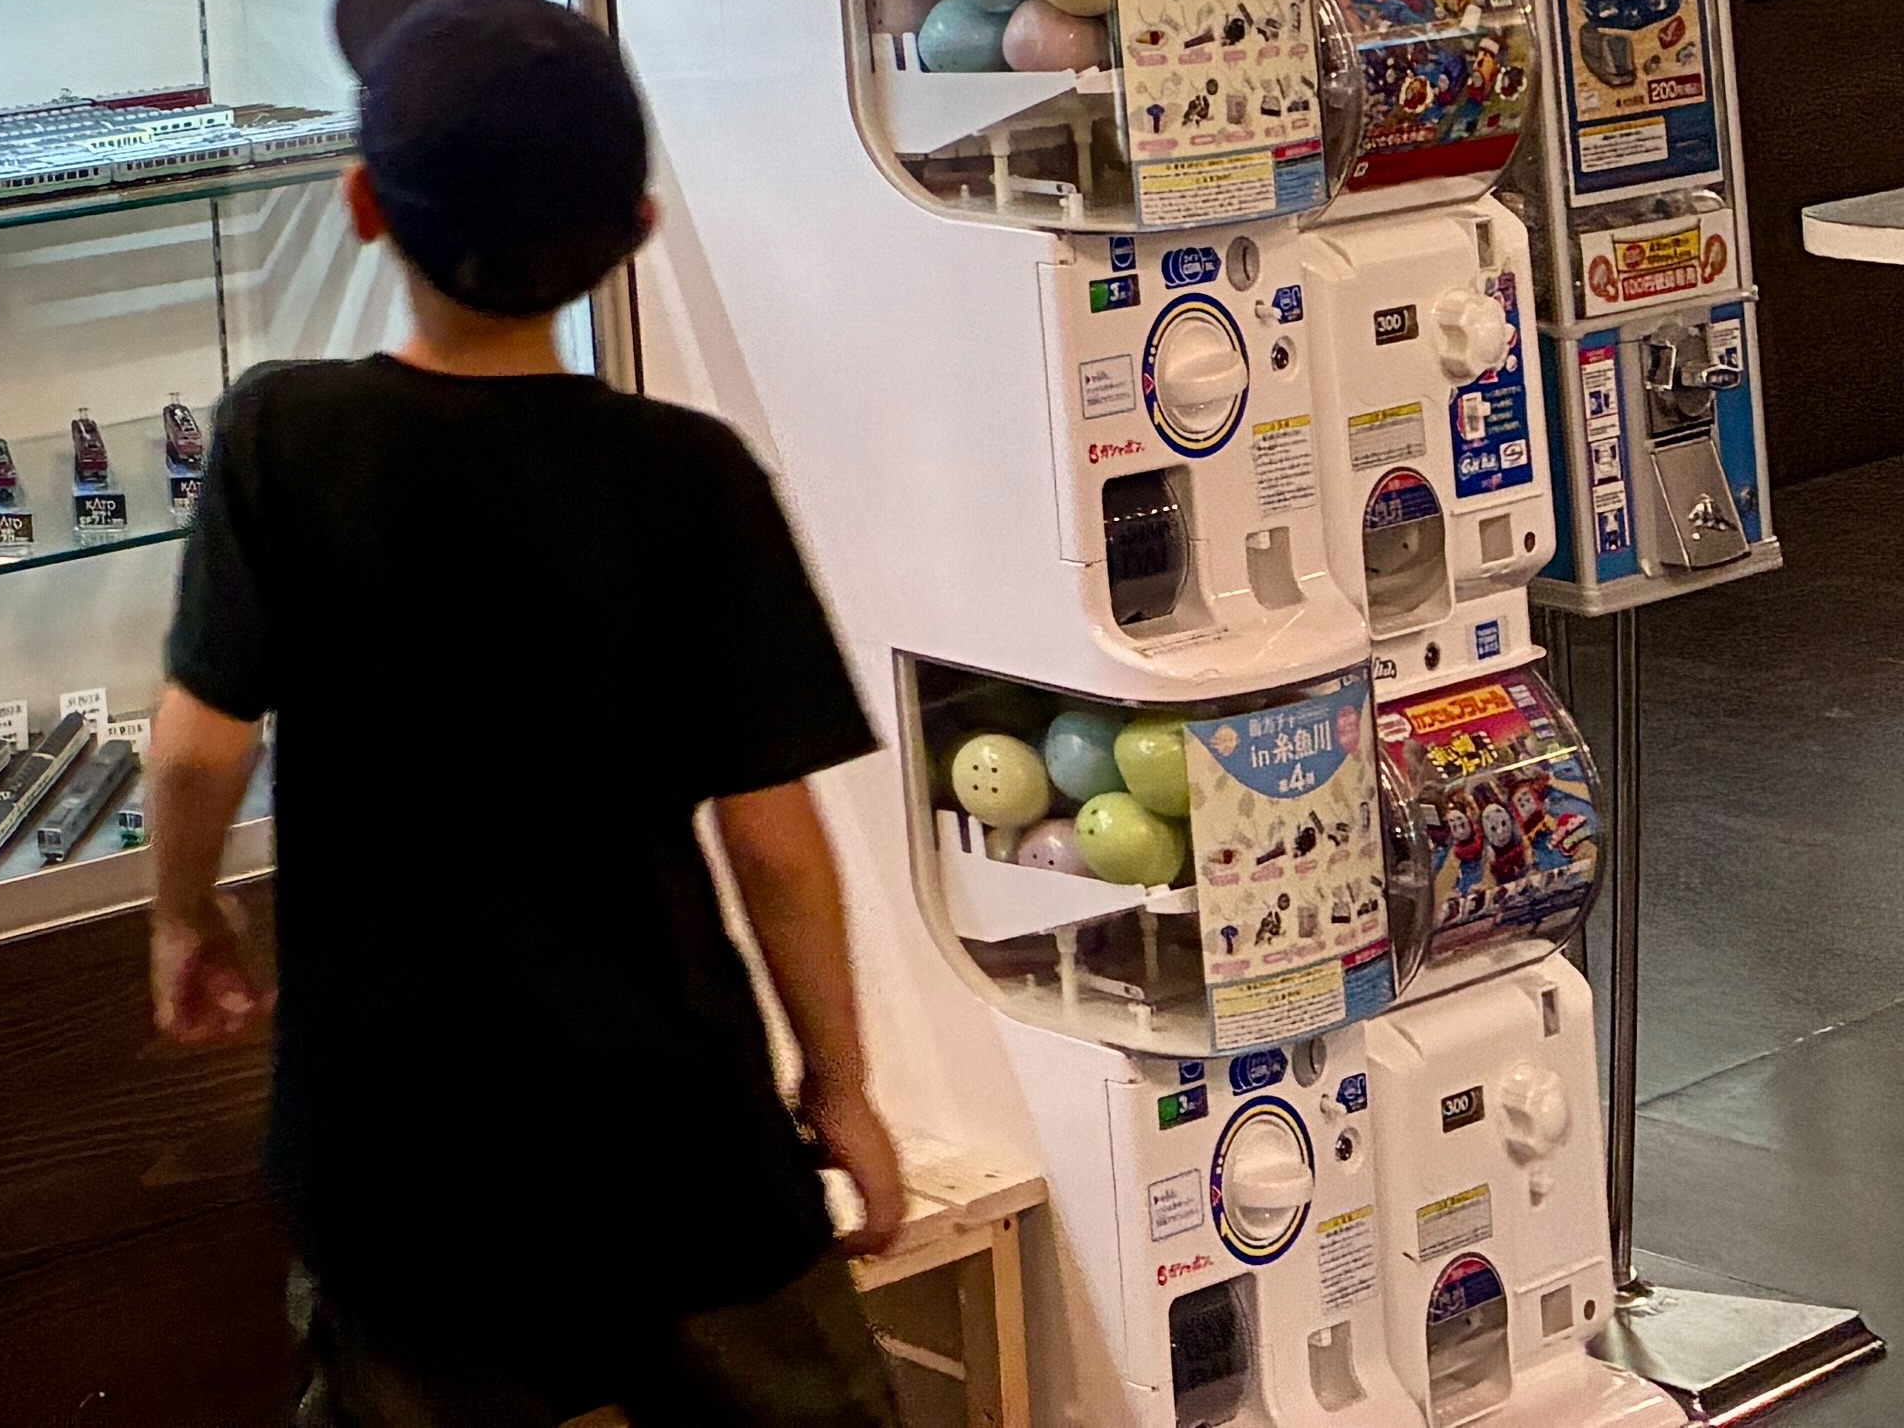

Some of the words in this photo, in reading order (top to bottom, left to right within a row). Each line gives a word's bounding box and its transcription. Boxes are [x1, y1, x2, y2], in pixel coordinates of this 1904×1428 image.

[1376, 313, 1403, 333] 300
[1250, 744, 1271, 769] in
[1272, 719, 1333, 766] 糸魚川
[1442, 1094, 1471, 1117] 300
